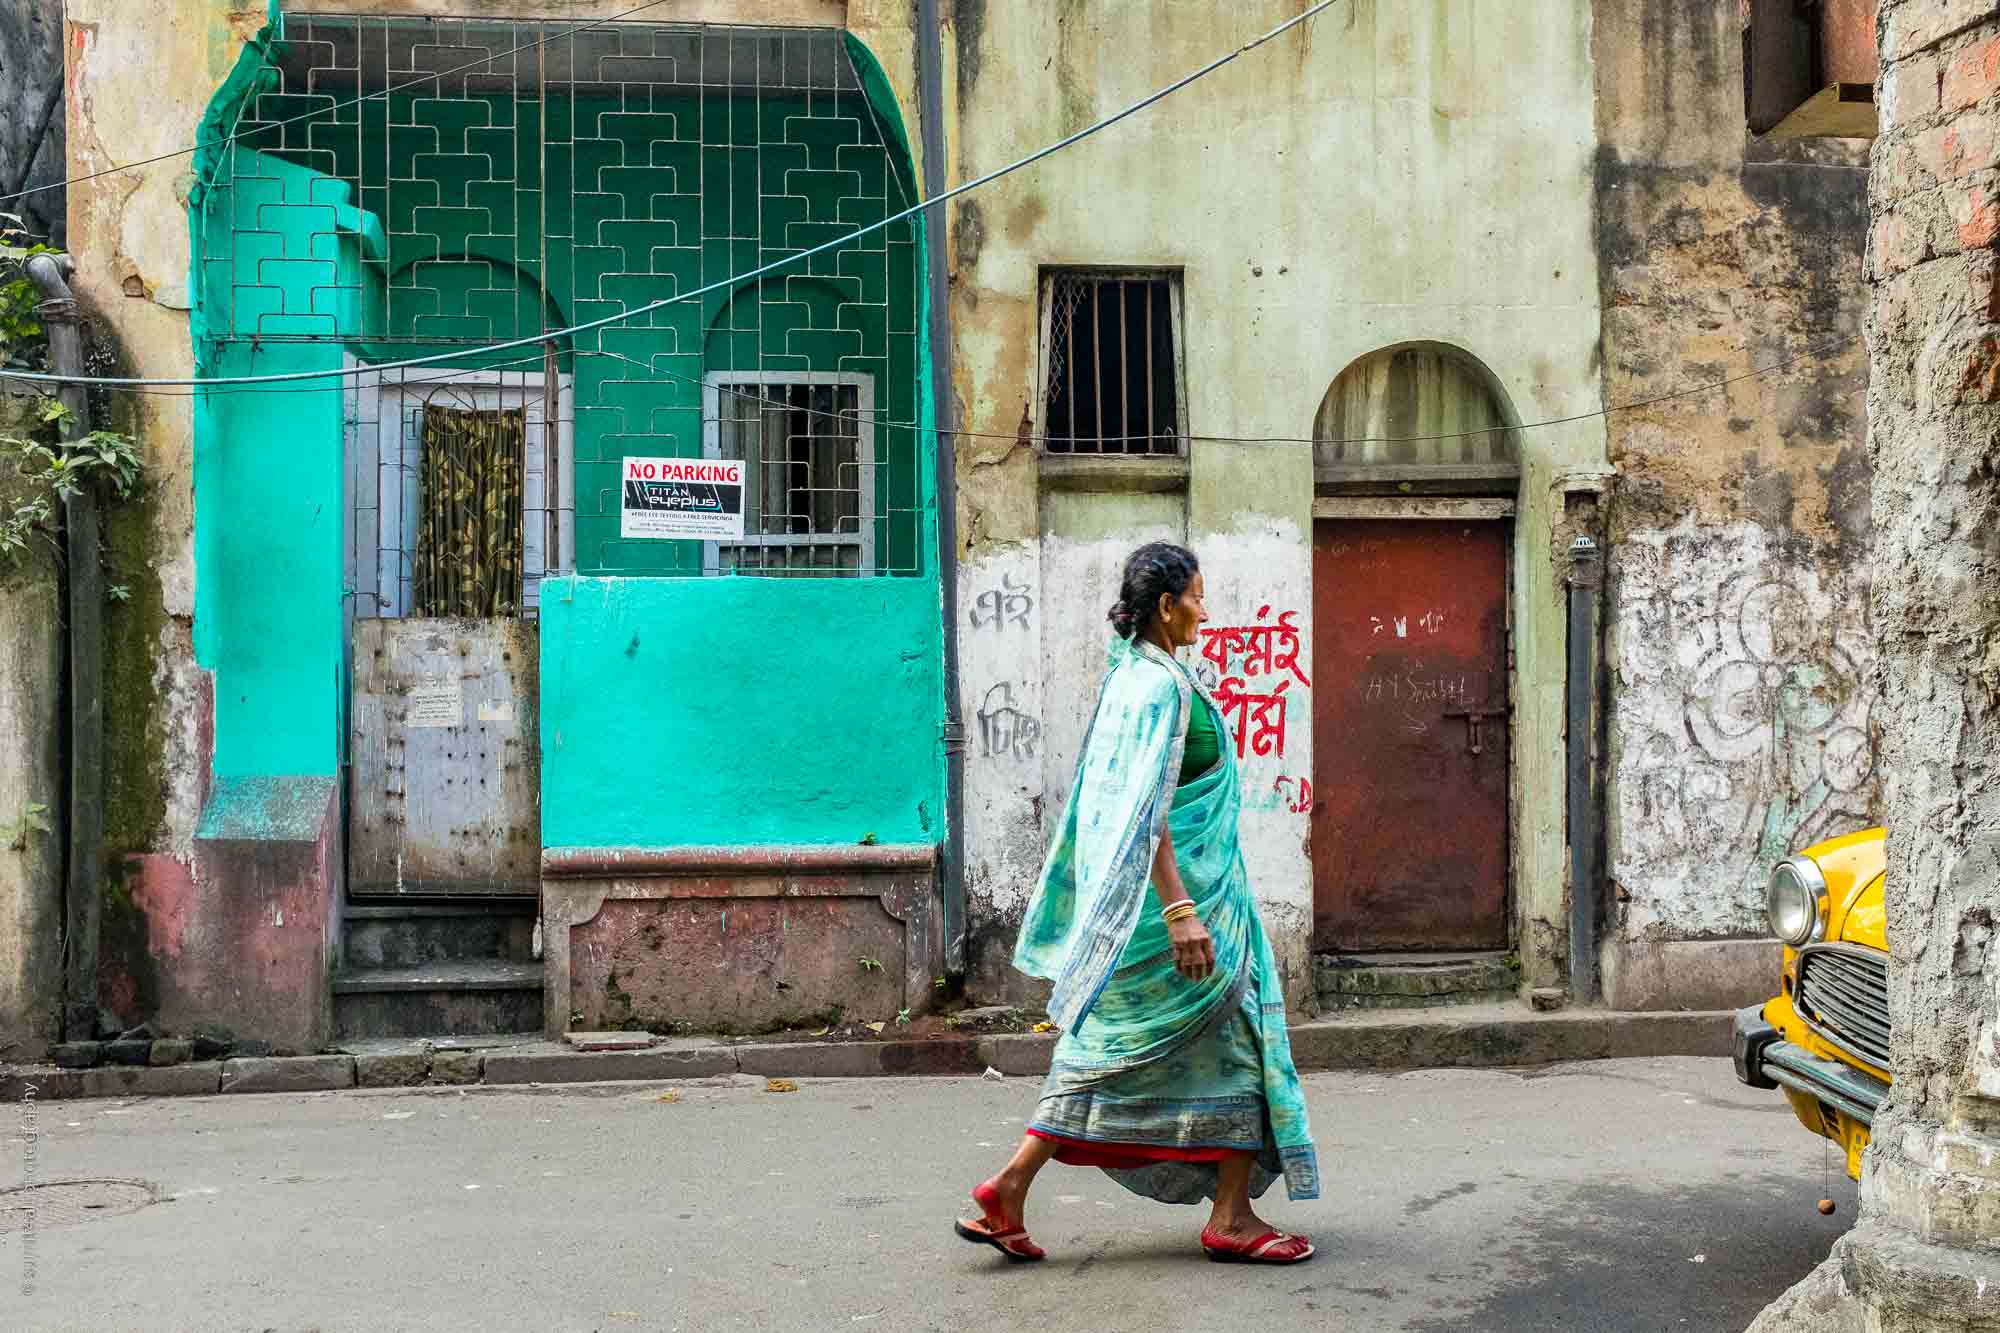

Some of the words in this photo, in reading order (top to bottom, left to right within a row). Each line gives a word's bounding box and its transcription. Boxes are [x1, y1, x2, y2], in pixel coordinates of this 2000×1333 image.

[630, 463, 656, 479] NO
[662, 464, 739, 482] PARKING
[650, 487, 689, 496] TITAN
[649, 495, 717, 508] eyeplus
